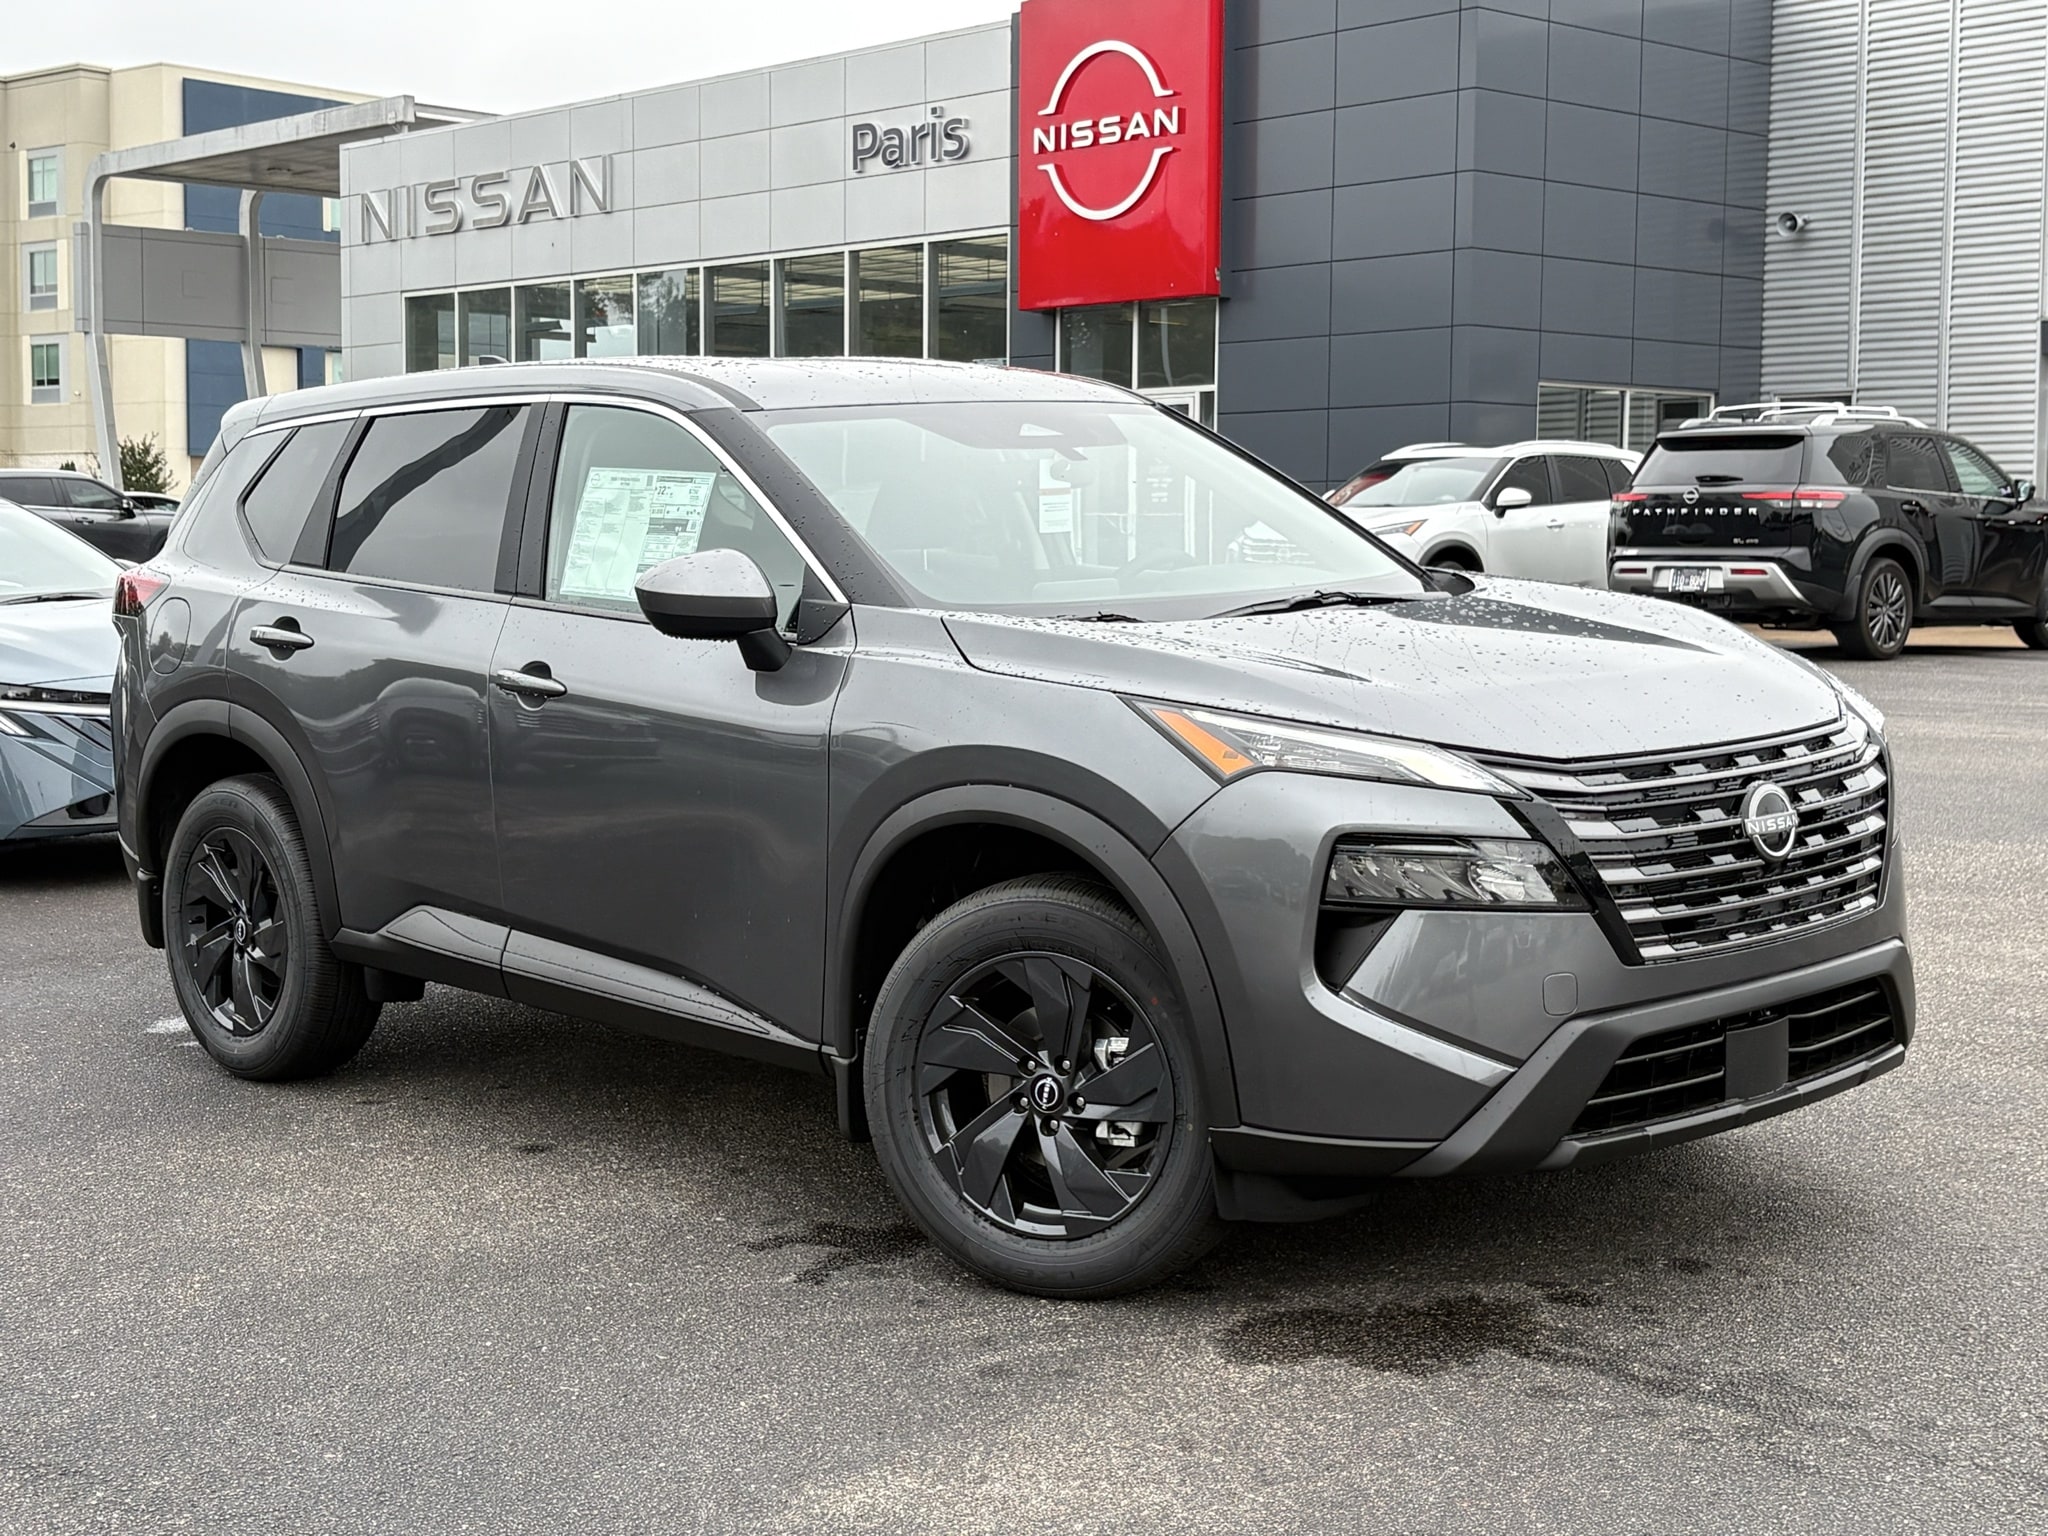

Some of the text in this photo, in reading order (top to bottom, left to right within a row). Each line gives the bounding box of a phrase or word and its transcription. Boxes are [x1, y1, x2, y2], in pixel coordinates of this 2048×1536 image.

[852, 106, 969, 173] Paris
[1033, 106, 1179, 155] NISSAN
[360, 154, 612, 245] NISSAN
[1632, 507, 1758, 516] PATHFINDER
[1747, 813, 1799, 834] NISSAN
